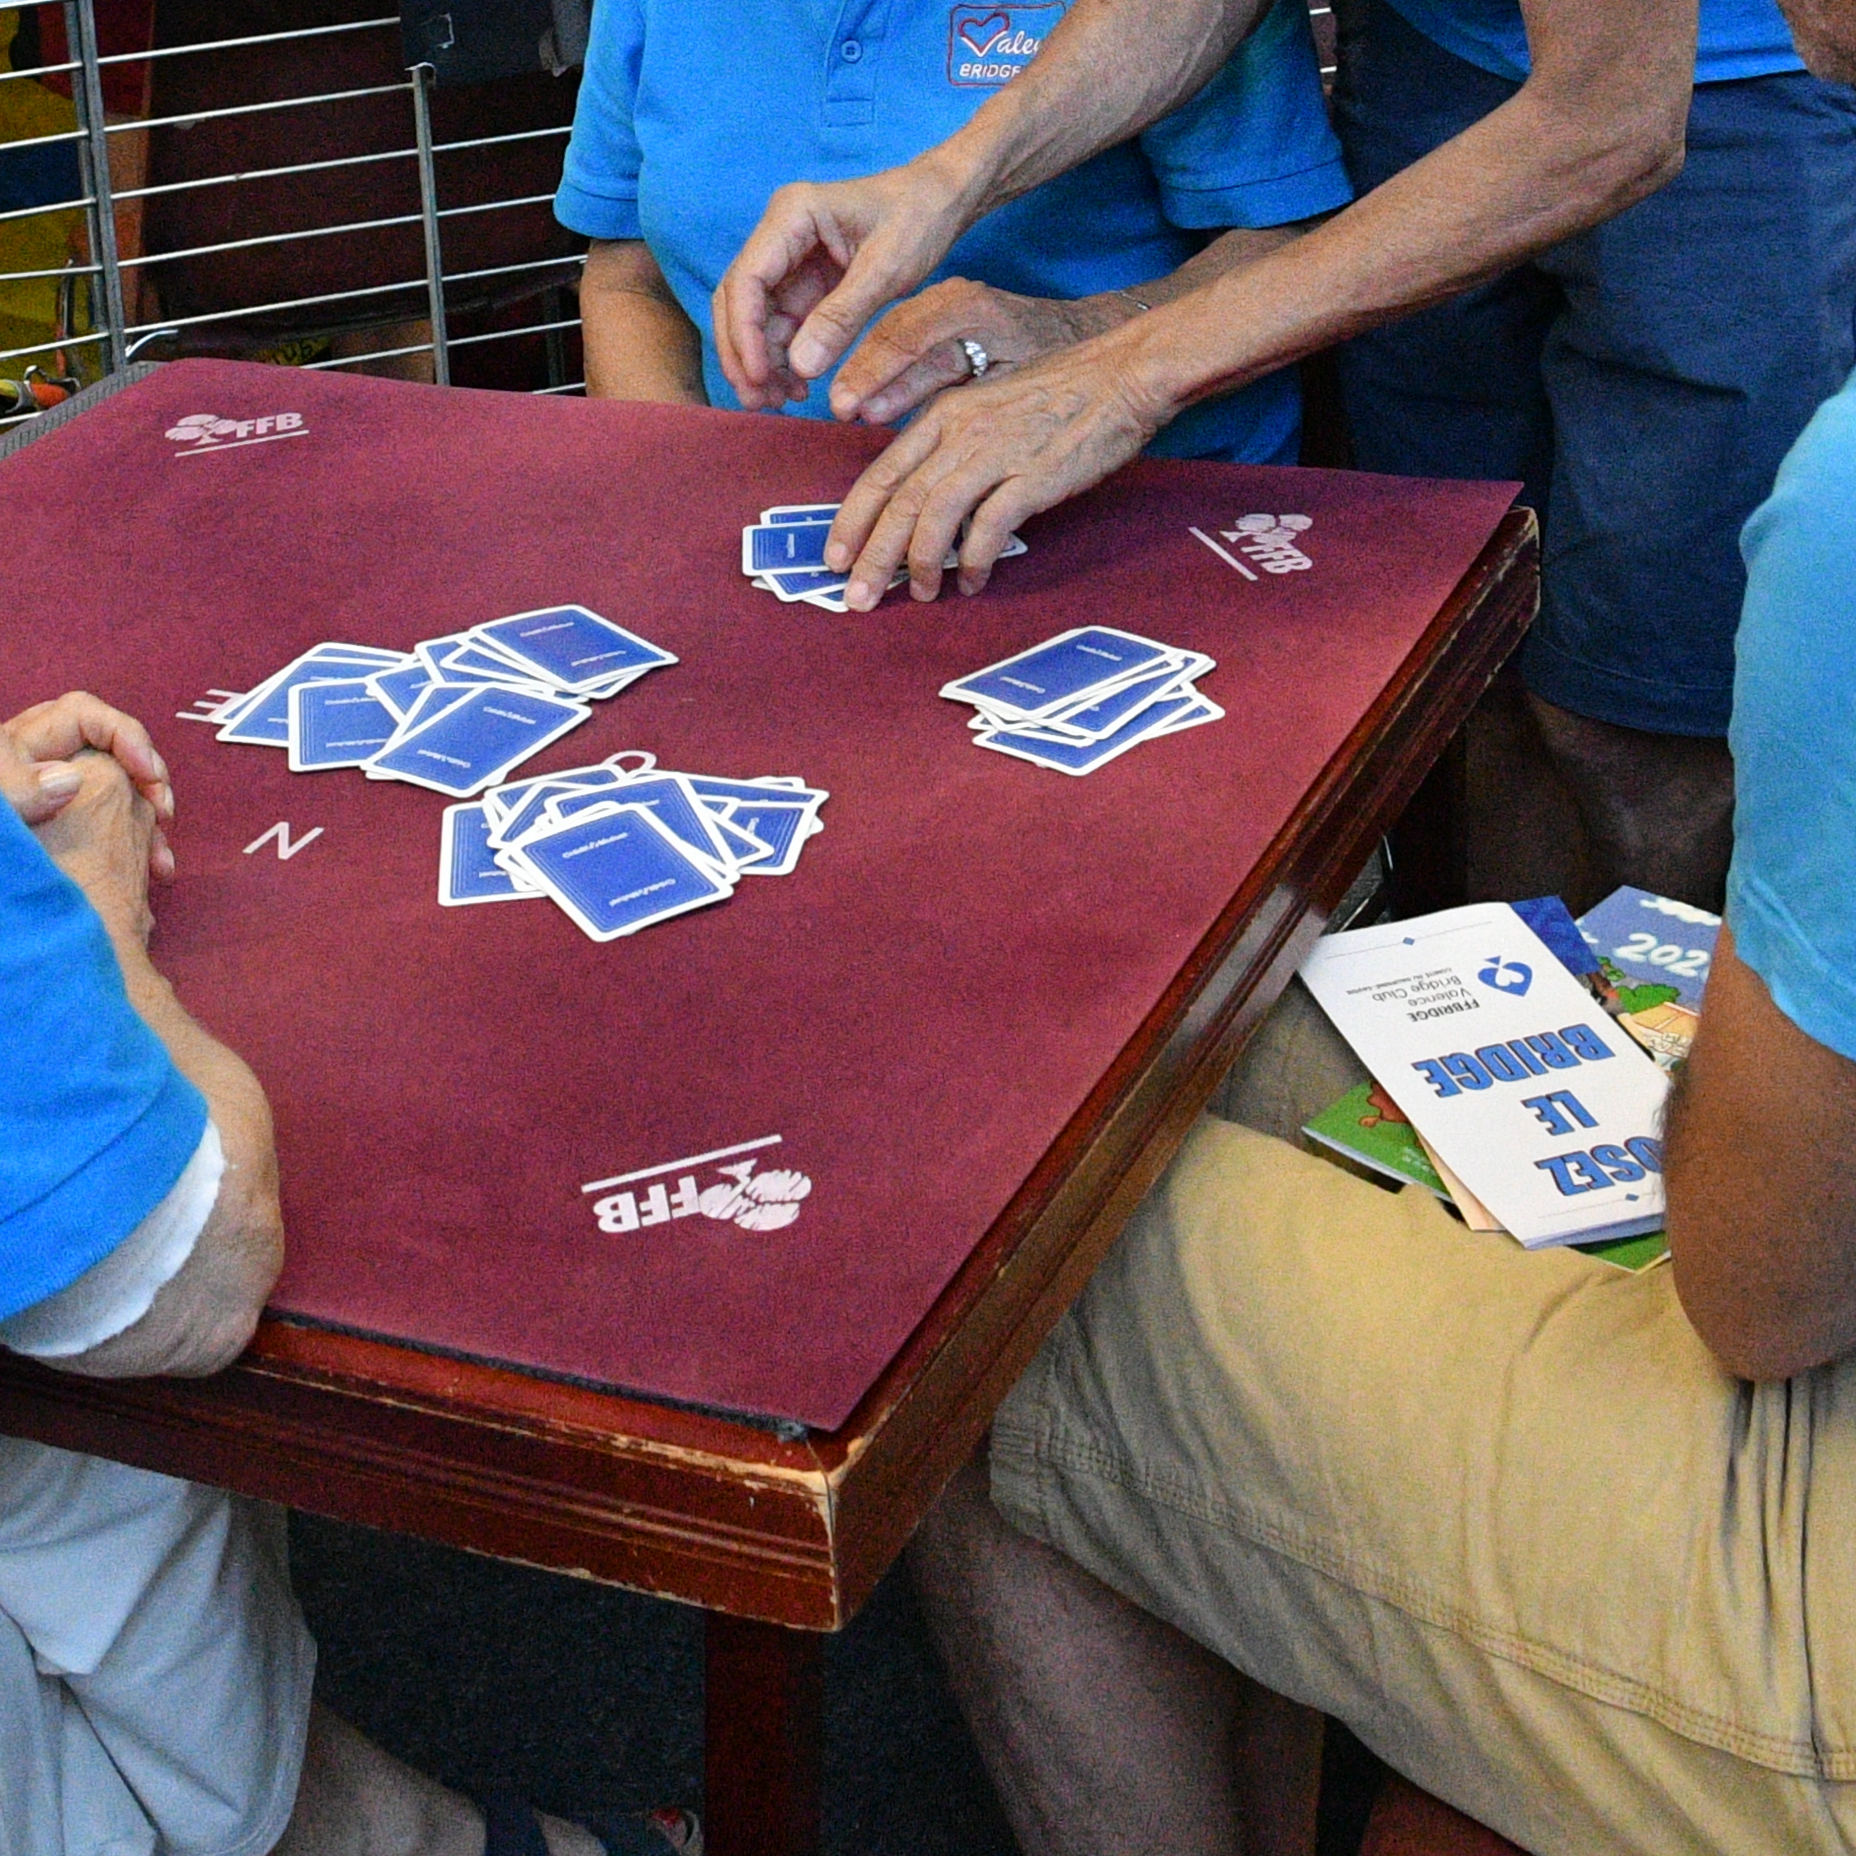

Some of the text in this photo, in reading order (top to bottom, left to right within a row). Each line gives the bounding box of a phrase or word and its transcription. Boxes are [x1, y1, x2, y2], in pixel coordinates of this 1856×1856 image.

[236, 412, 304, 439] FFB
[1240, 542, 1314, 575] FFB
[1613, 932, 1709, 981] 202
[1371, 987, 1408, 1003] Club
[1407, 987, 1472, 1007] Valence
[1410, 974, 1463, 993] Bridge
[1406, 998, 1481, 1023] FFBRIDGE
[1411, 1023, 1616, 1098] BRIDGE
[1520, 1089, 1600, 1136] LE
[1533, 1136, 1665, 1196] OSEZ
[593, 1175, 701, 1234] FFB
